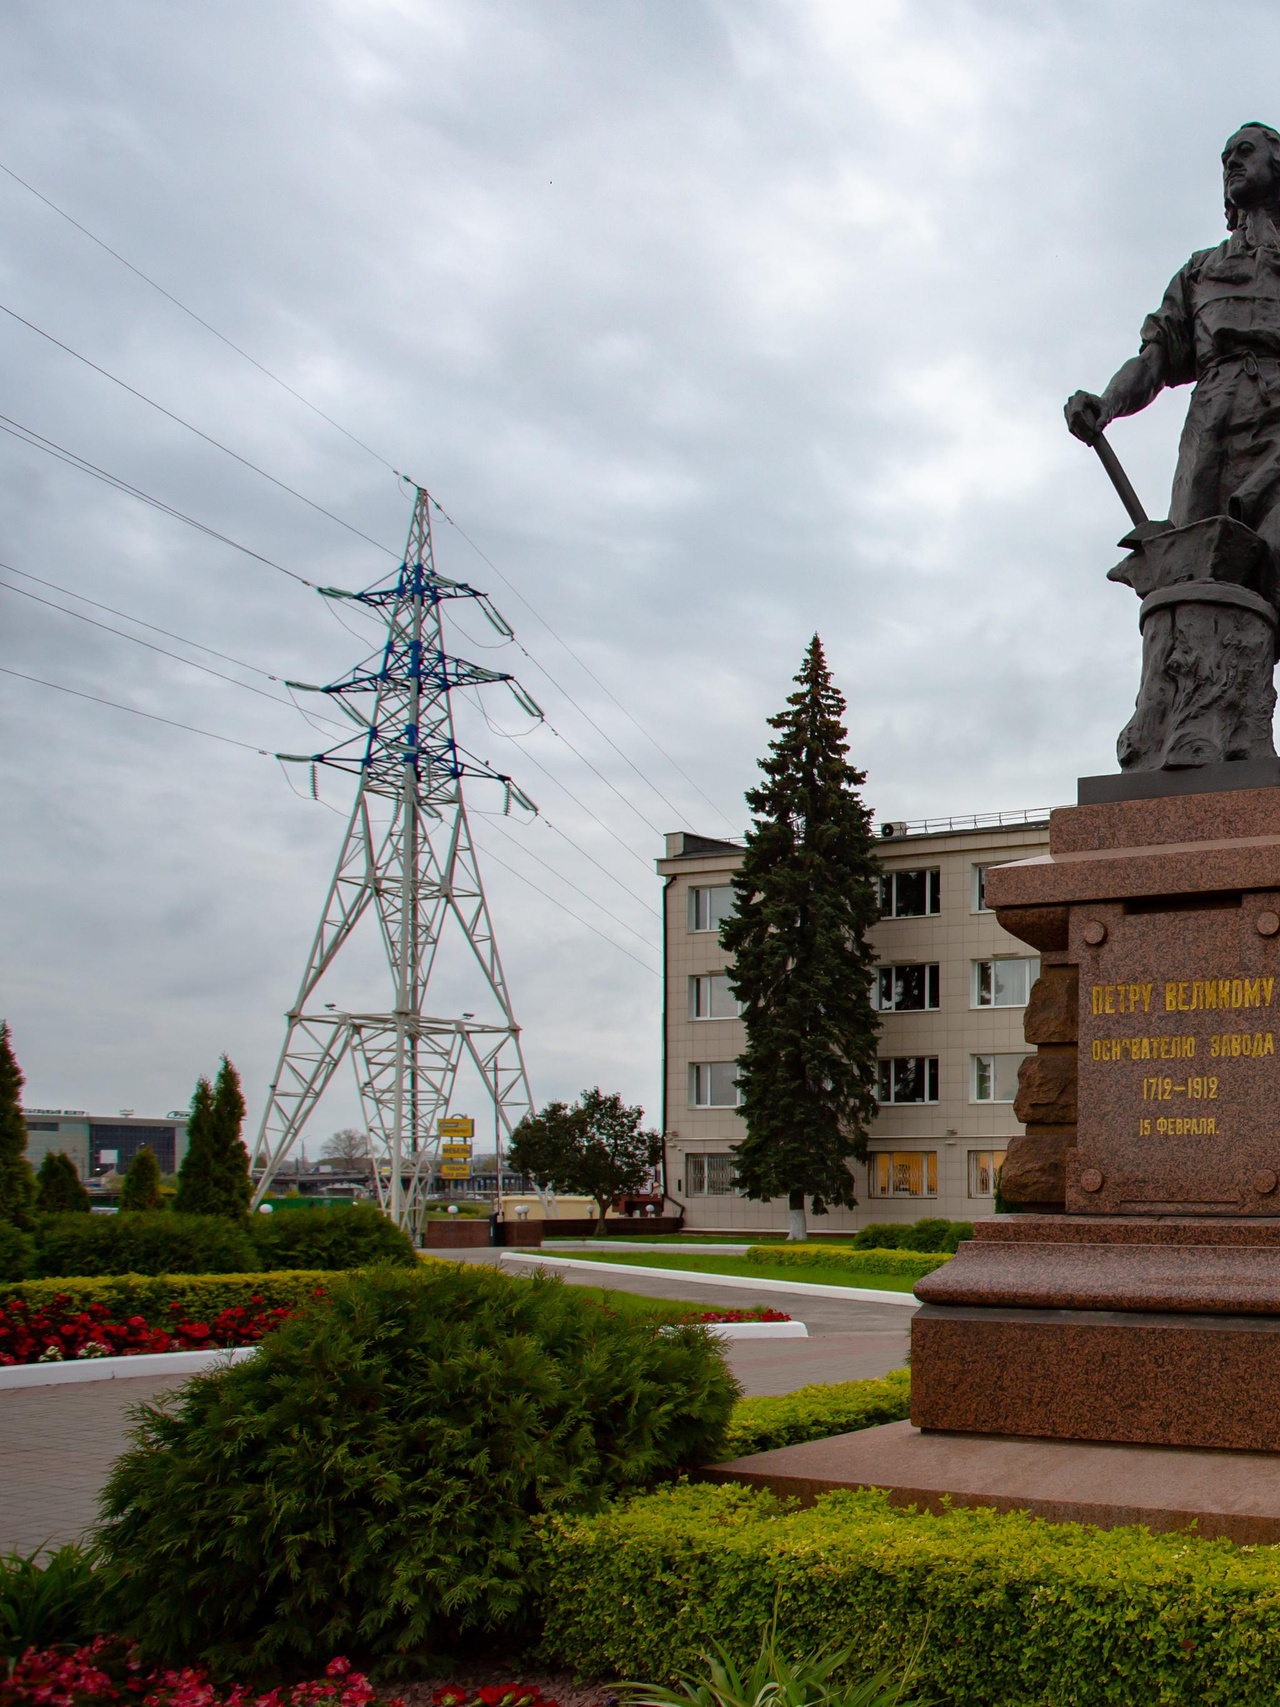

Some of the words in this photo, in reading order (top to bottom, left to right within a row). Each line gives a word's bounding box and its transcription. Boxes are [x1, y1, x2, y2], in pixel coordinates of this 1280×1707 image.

[1092, 983, 1153, 1015] ПЕТРУ
[1165, 977, 1275, 1011] ВЕЛИКОМУ
[1210, 1033, 1274, 1058] ЗАВОДА
[1140, 1119, 1151, 1136] 15
